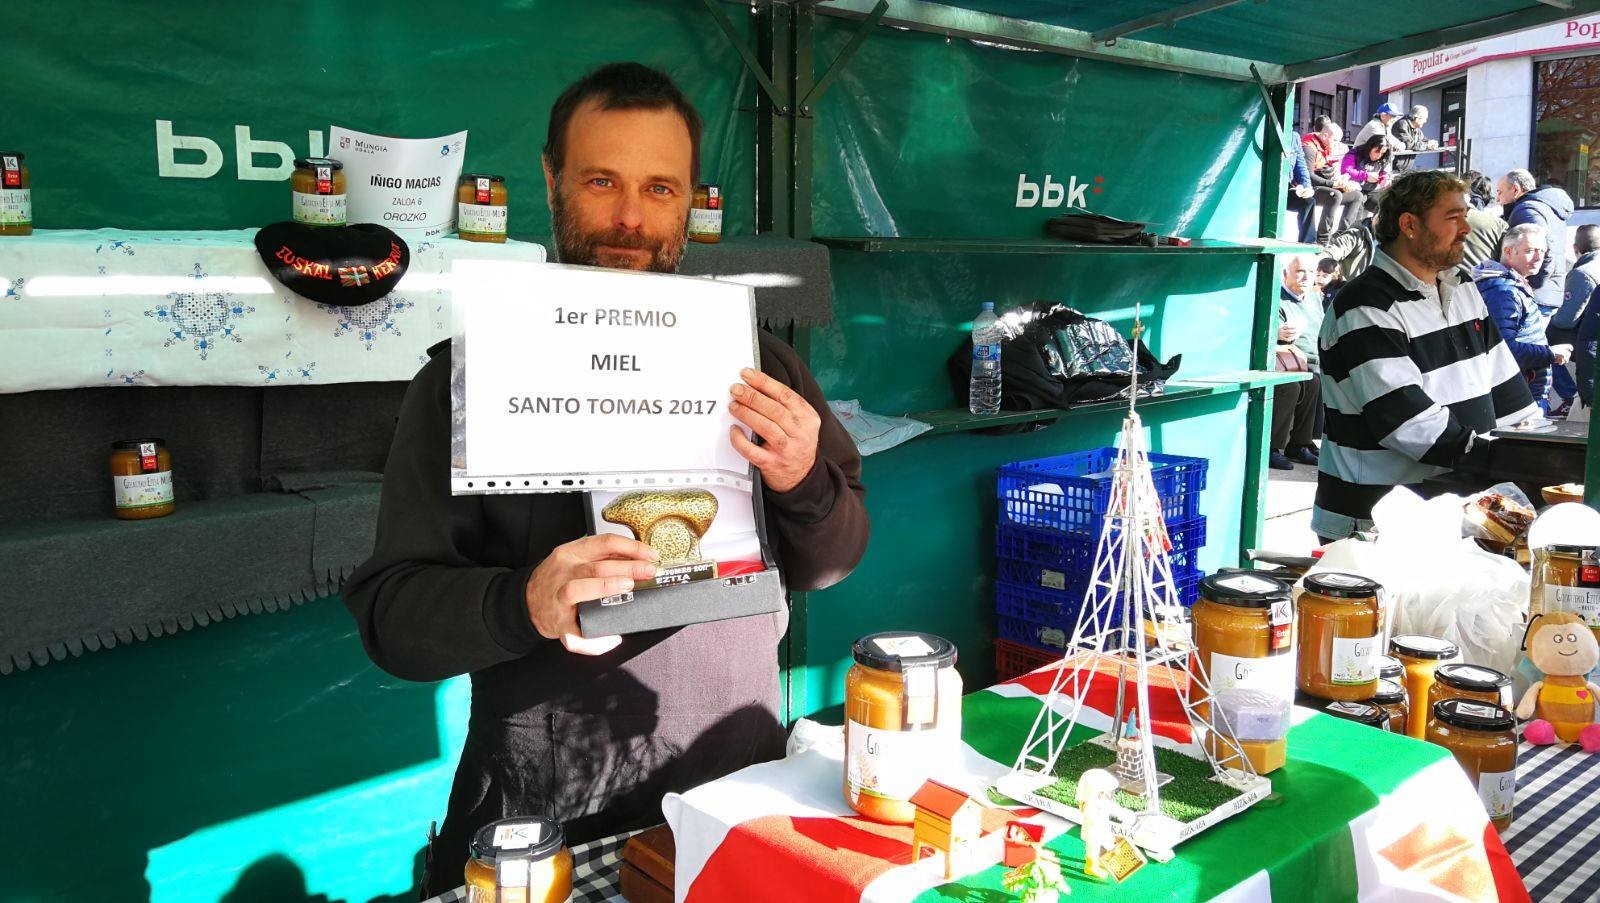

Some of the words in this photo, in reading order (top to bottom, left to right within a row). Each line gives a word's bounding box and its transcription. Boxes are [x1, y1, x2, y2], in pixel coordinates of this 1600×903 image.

[1413, 52, 1444, 74] Popular
[155, 119, 324, 180] bb
[355, 139, 388, 152] MUNGIA
[370, 173, 402, 189] IÑIGO
[405, 175, 442, 190] MACIAS
[1015, 173, 1090, 208] bbk
[391, 197, 416, 206] ZALOA
[417, 197, 423, 206] 6
[383, 211, 427, 222] OROZKO
[425, 229, 441, 237] bbk
[275, 245, 333, 280] EUSKAL
[554, 306, 588, 326] 1er
[594, 307, 677, 328] PREMIO
[590, 353, 641, 372] MIEL
[508, 396, 581, 415] SANTO
[586, 398, 663, 416] TOMAS
[668, 398, 717, 416] 2017
[656, 573, 691, 585] EZTIA
[1232, 791, 1258, 811] BIZKAIA
